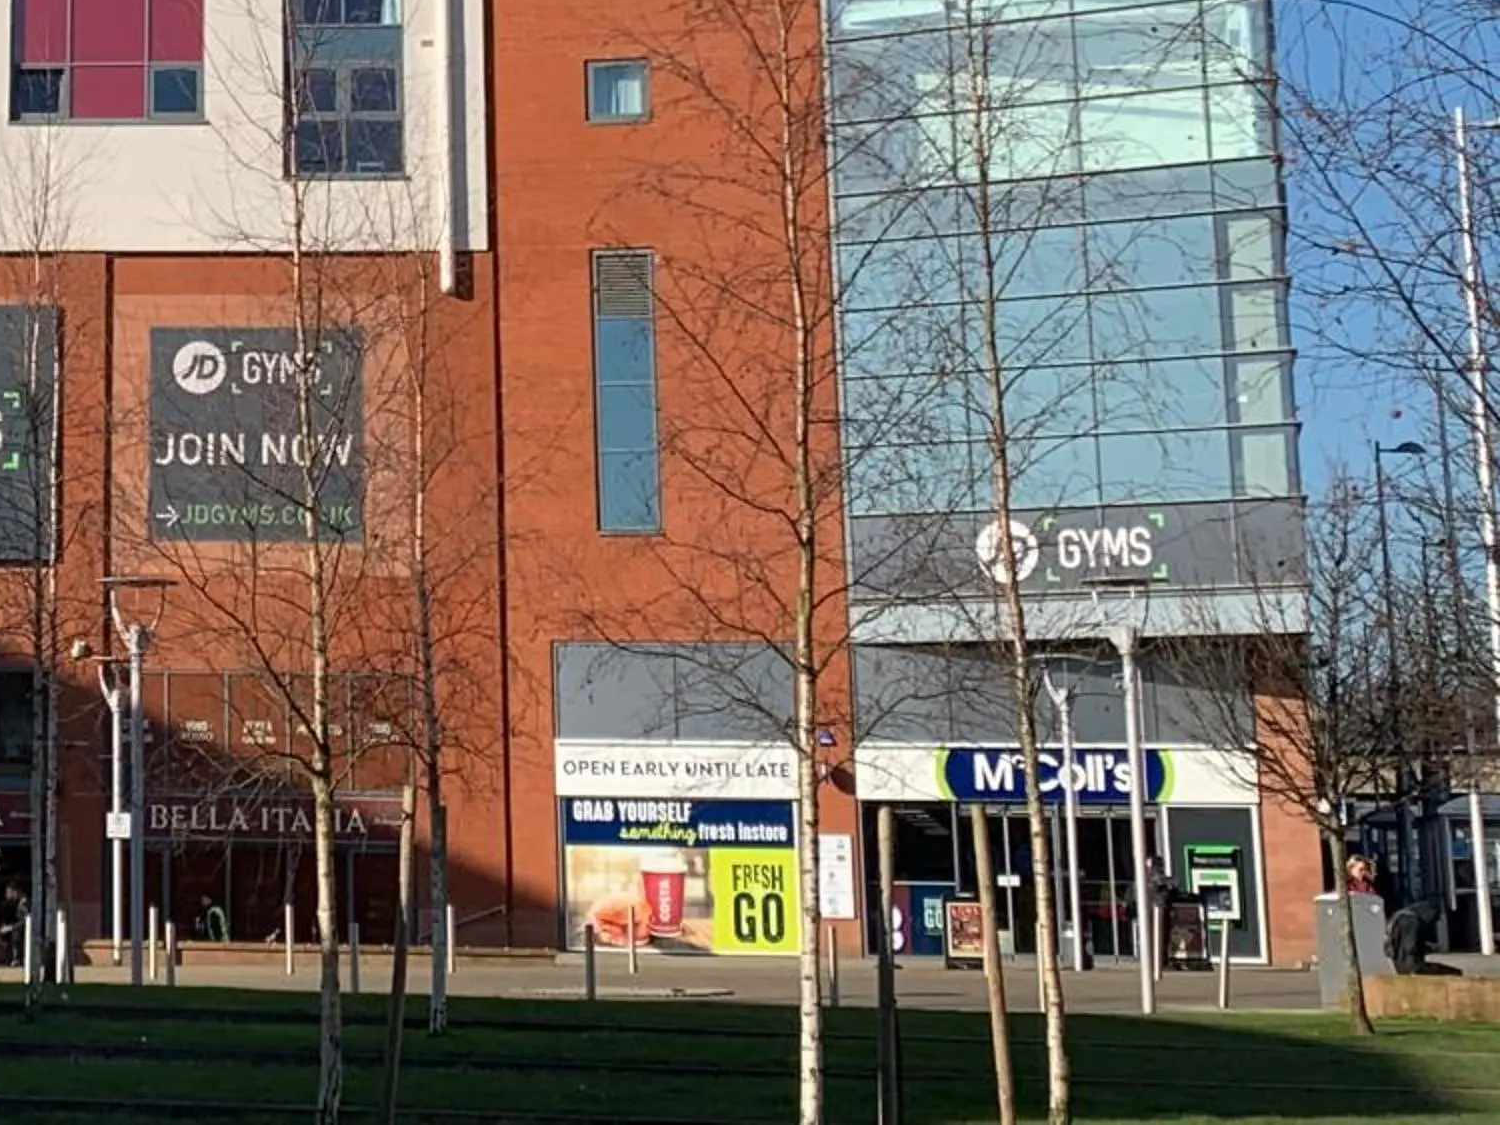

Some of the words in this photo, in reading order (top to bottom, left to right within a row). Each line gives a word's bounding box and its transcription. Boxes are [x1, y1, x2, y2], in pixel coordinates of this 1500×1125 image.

[181, 354, 219, 380] JD
[155, 432, 246, 466] JOIN
[262, 432, 353, 467] NOW
[181, 505, 353, 525] JDGYMS.COUK
[1058, 525, 1152, 569] GYMS
[563, 760, 615, 776] OPEN
[621, 761, 680, 777] EARLY
[685, 762, 742, 778] UNTIL
[745, 763, 791, 779] LATE
[150, 804, 249, 831] BELLA
[261, 806, 367, 834] ITAIA
[572, 800, 615, 822] GRAB
[618, 801, 693, 823] YOURSELF
[699, 821, 736, 841] fresh
[738, 820, 788, 842] instore
[732, 864, 784, 891] FRESH
[733, 892, 785, 945] GO
